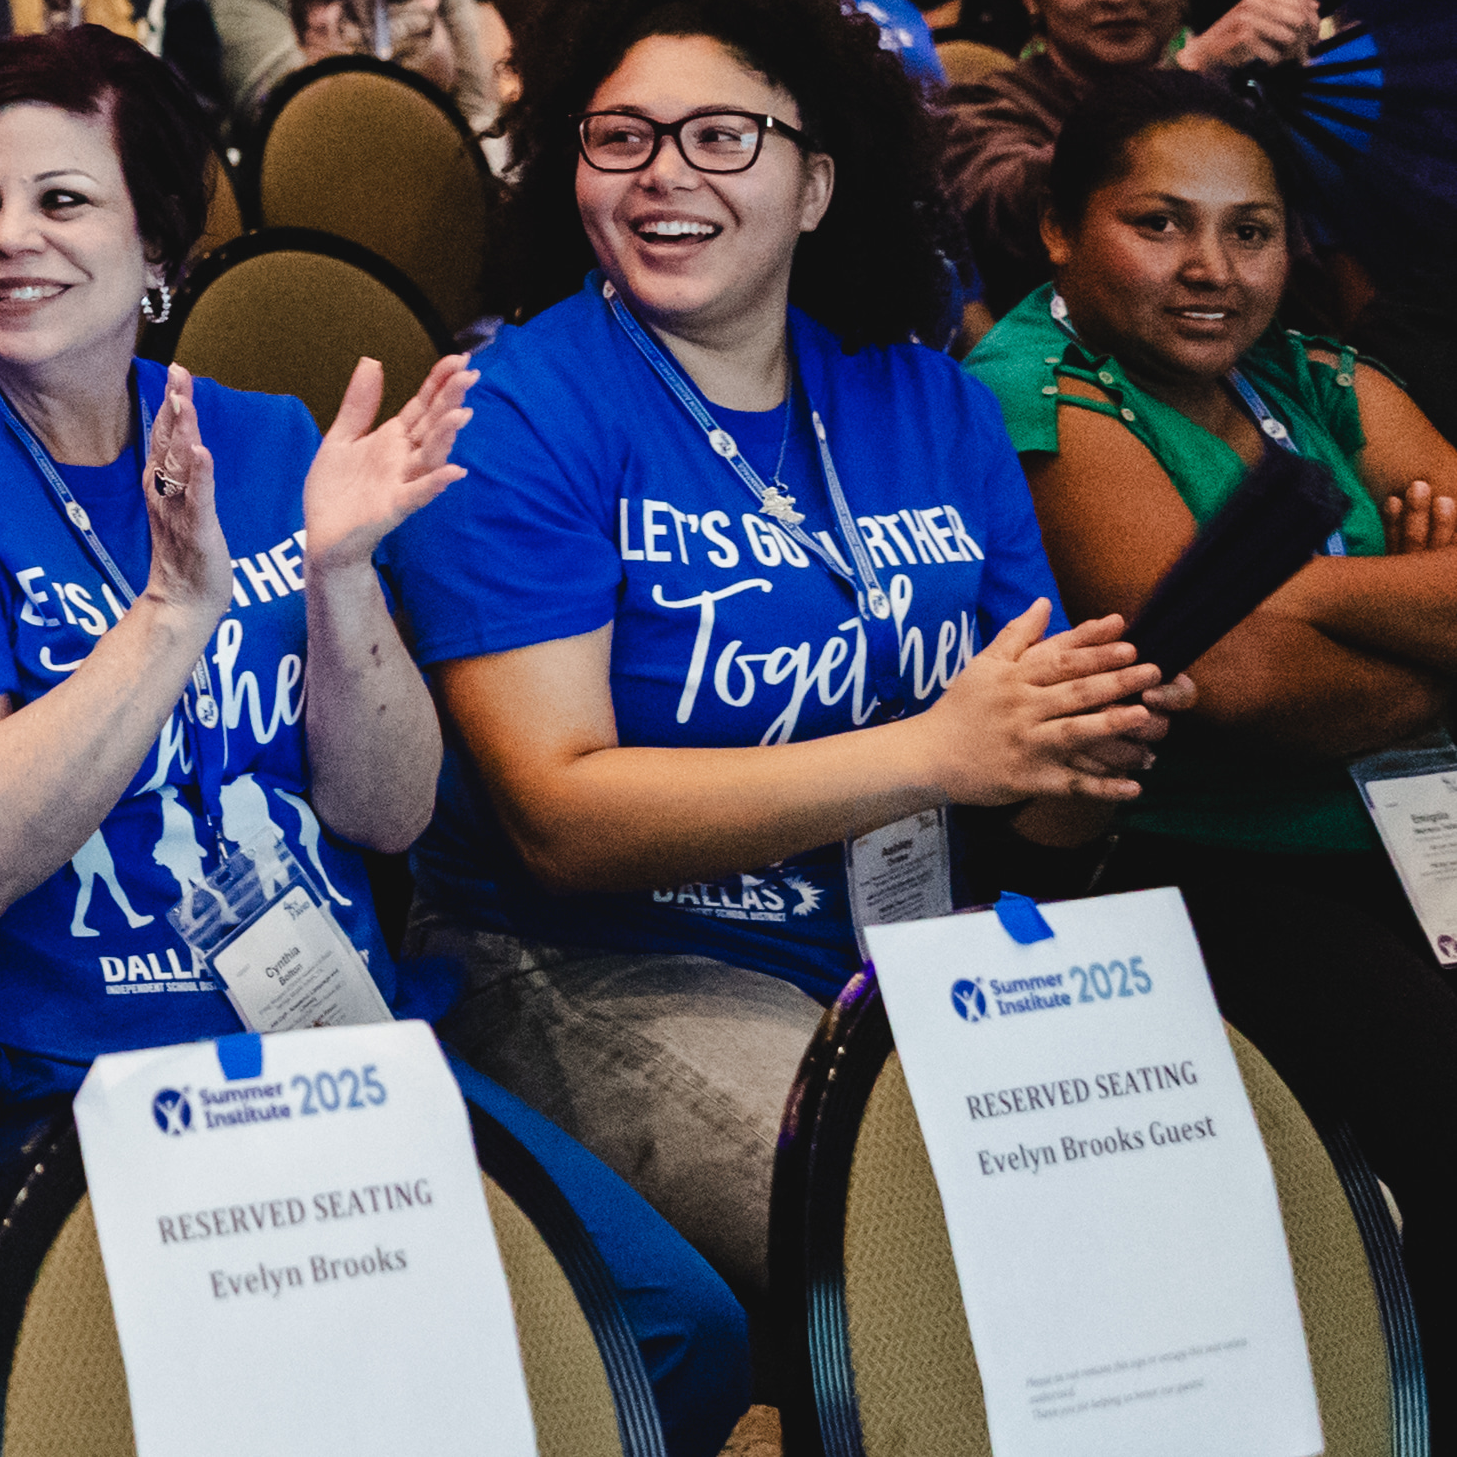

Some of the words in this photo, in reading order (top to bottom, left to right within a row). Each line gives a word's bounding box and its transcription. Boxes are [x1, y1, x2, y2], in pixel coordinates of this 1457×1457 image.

[620, 498, 739, 569] LET'S
[742, 513, 810, 569] GO
[813, 505, 985, 570] RTHER
[99, 948, 211, 982] DALLA
[264, 946, 301, 979] Cynthia
[990, 972, 1063, 996] Summer
[1069, 956, 1152, 1003] 2025
[995, 991, 1072, 1017] Institute
[199, 1080, 284, 1107] Summer
[291, 1064, 387, 1115] 2025
[966, 1077, 1090, 1121] RESERVED
[1094, 1060, 1198, 1101] SEATING
[205, 1101, 291, 1130] Institute
[977, 1141, 1057, 1177] Evelyn
[1061, 1125, 1144, 1162] Brooks
[1148, 1114, 1217, 1148] Guest
[158, 1197, 306, 1244] RESERVED
[314, 1178, 433, 1221] SEATING
[209, 1263, 304, 1299] Evelyn
[310, 1246, 408, 1284] Brooks
